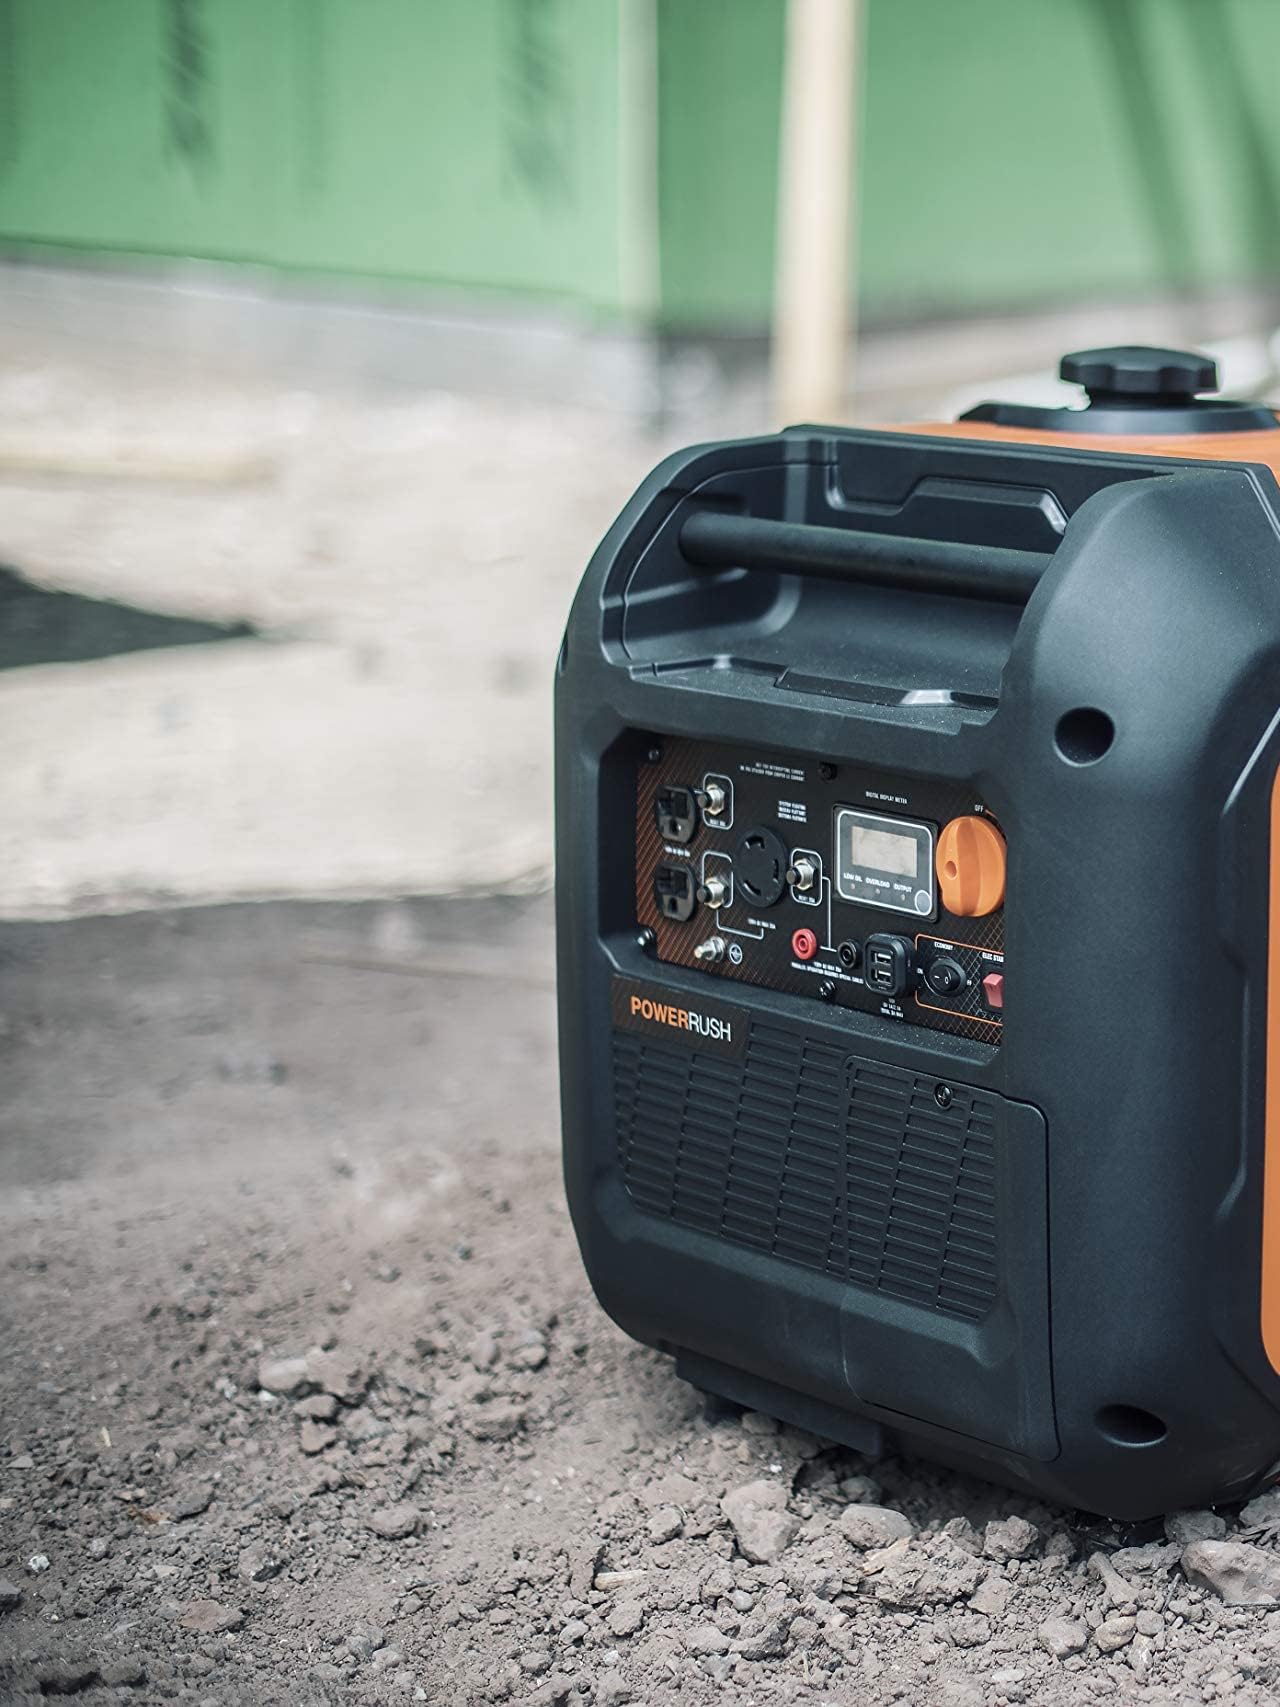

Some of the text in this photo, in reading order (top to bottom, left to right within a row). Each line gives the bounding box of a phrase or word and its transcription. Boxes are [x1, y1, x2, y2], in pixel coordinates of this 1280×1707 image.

[974, 804, 984, 813] OFF
[843, 872, 855, 880] LOW
[865, 877, 891, 889] OVERLOAD
[893, 882, 913, 893] OUTPUT
[630, 995, 732, 1042] POWERRUSH
